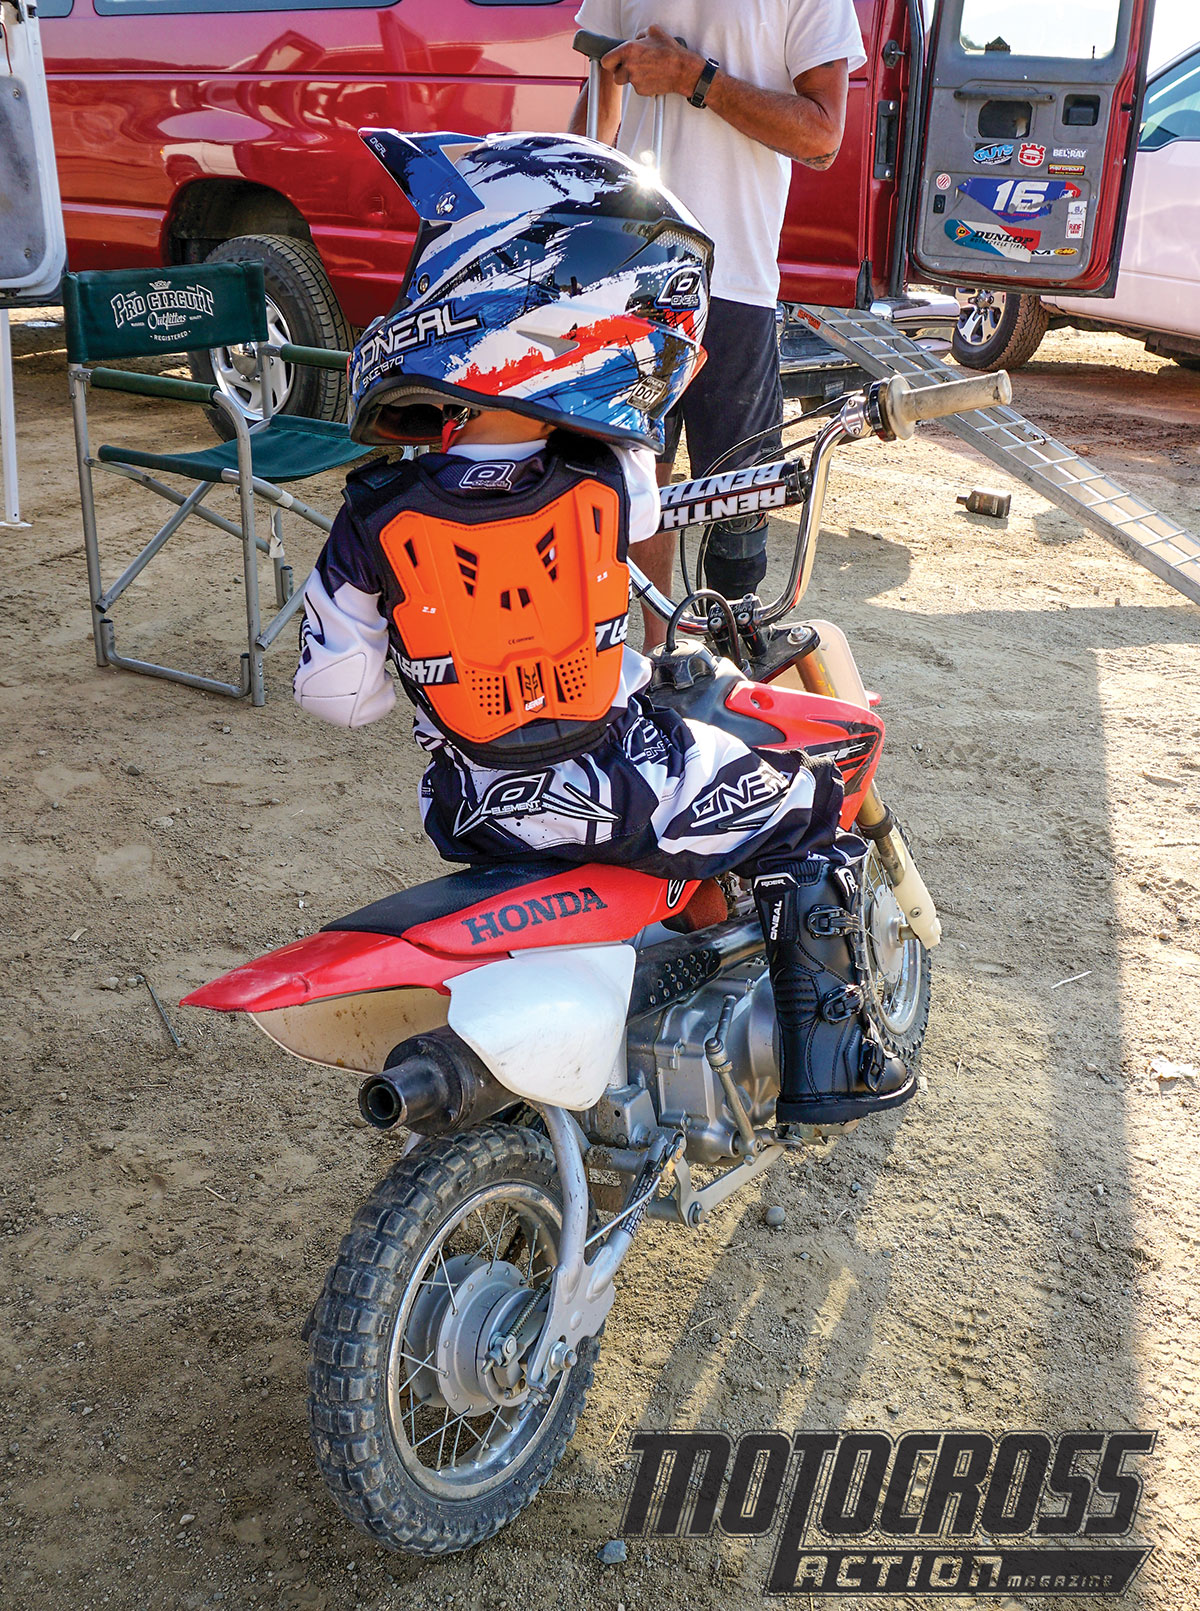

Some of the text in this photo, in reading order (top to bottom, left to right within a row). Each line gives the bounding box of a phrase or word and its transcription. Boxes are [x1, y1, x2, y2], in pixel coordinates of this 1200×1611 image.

[973, 144, 1014, 161] GUTS
[993, 180, 1050, 213] 16
[973, 230, 1034, 245] DUNLOP
[111, 284, 214, 328] PRO CIRCUIT
[148, 311, 187, 330] Outfitters
[635, 385, 659, 401] DOT
[491, 800, 541, 815] ELEMENT
[461, 887, 608, 946] HONDA
